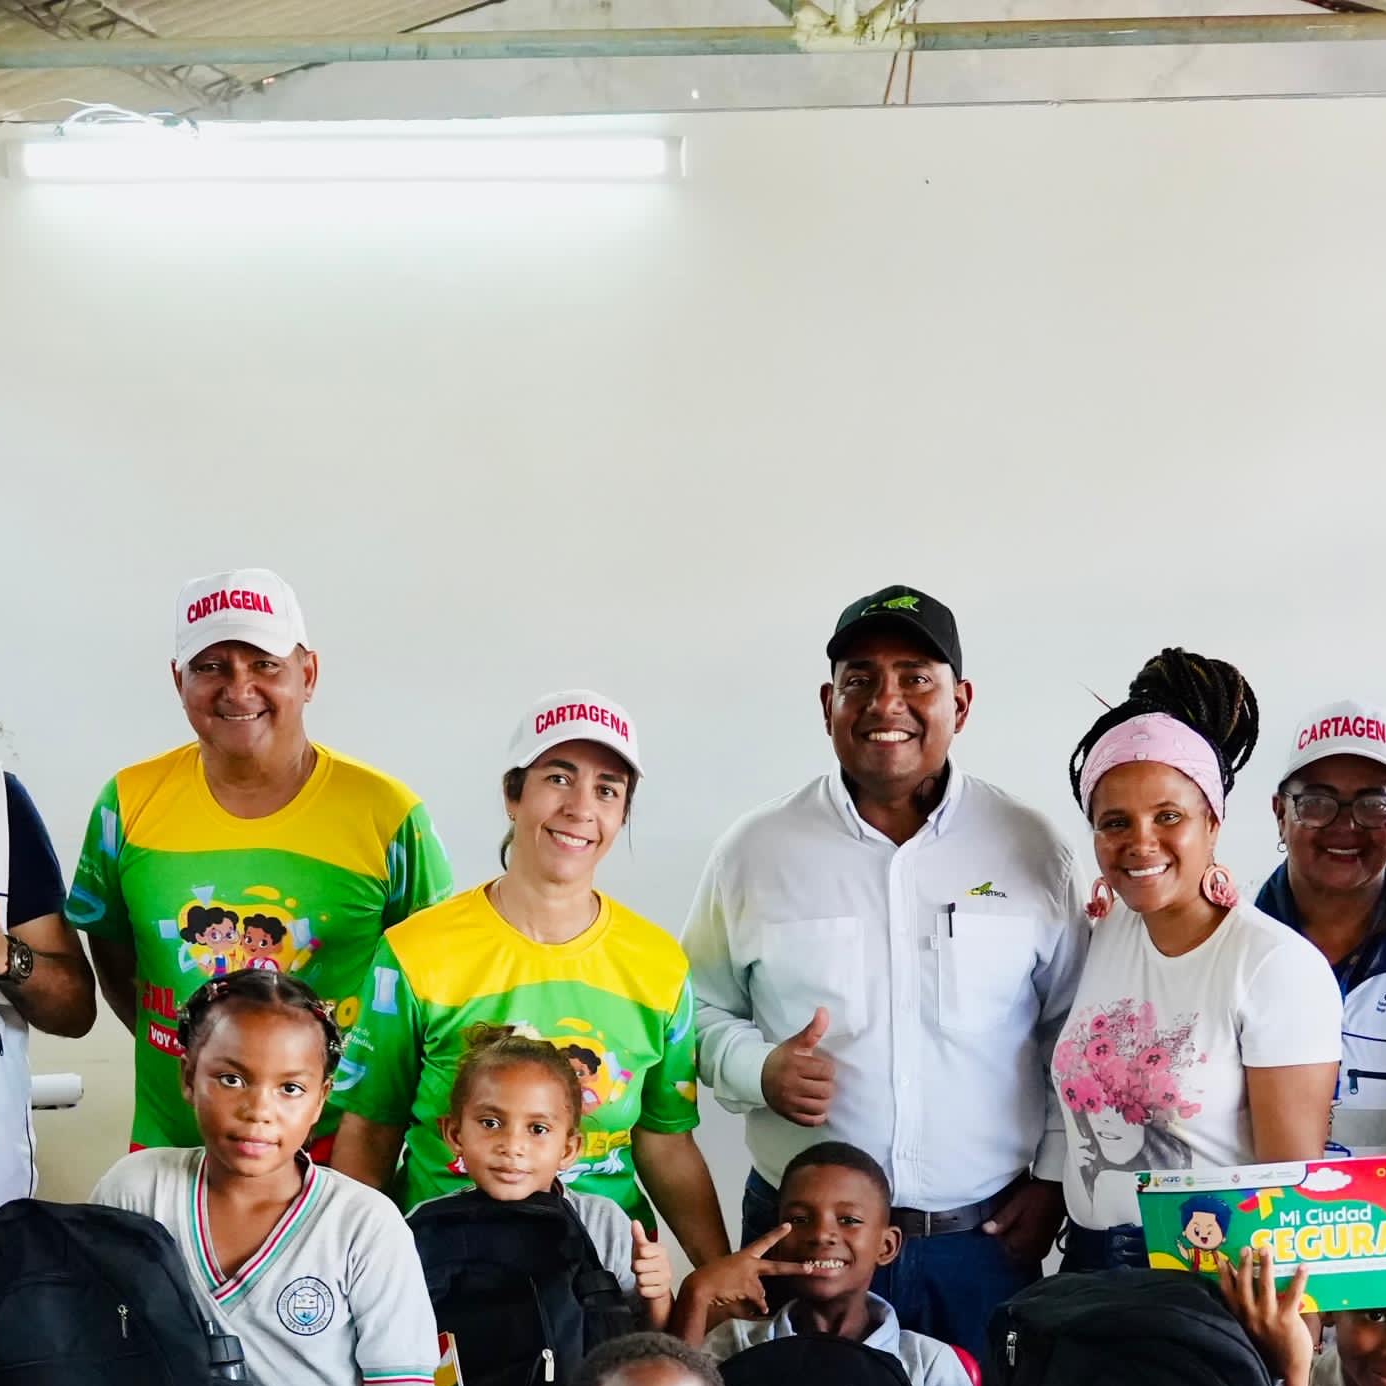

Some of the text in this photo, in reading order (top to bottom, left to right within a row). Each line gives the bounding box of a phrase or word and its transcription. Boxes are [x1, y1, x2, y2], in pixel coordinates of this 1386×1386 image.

[187, 589, 273, 624] CARTAGENA
[535, 703, 629, 742] CARTAGENA
[150, 1024, 172, 1048] VOY
[1279, 1204, 1372, 1227] Mi Ciudad
